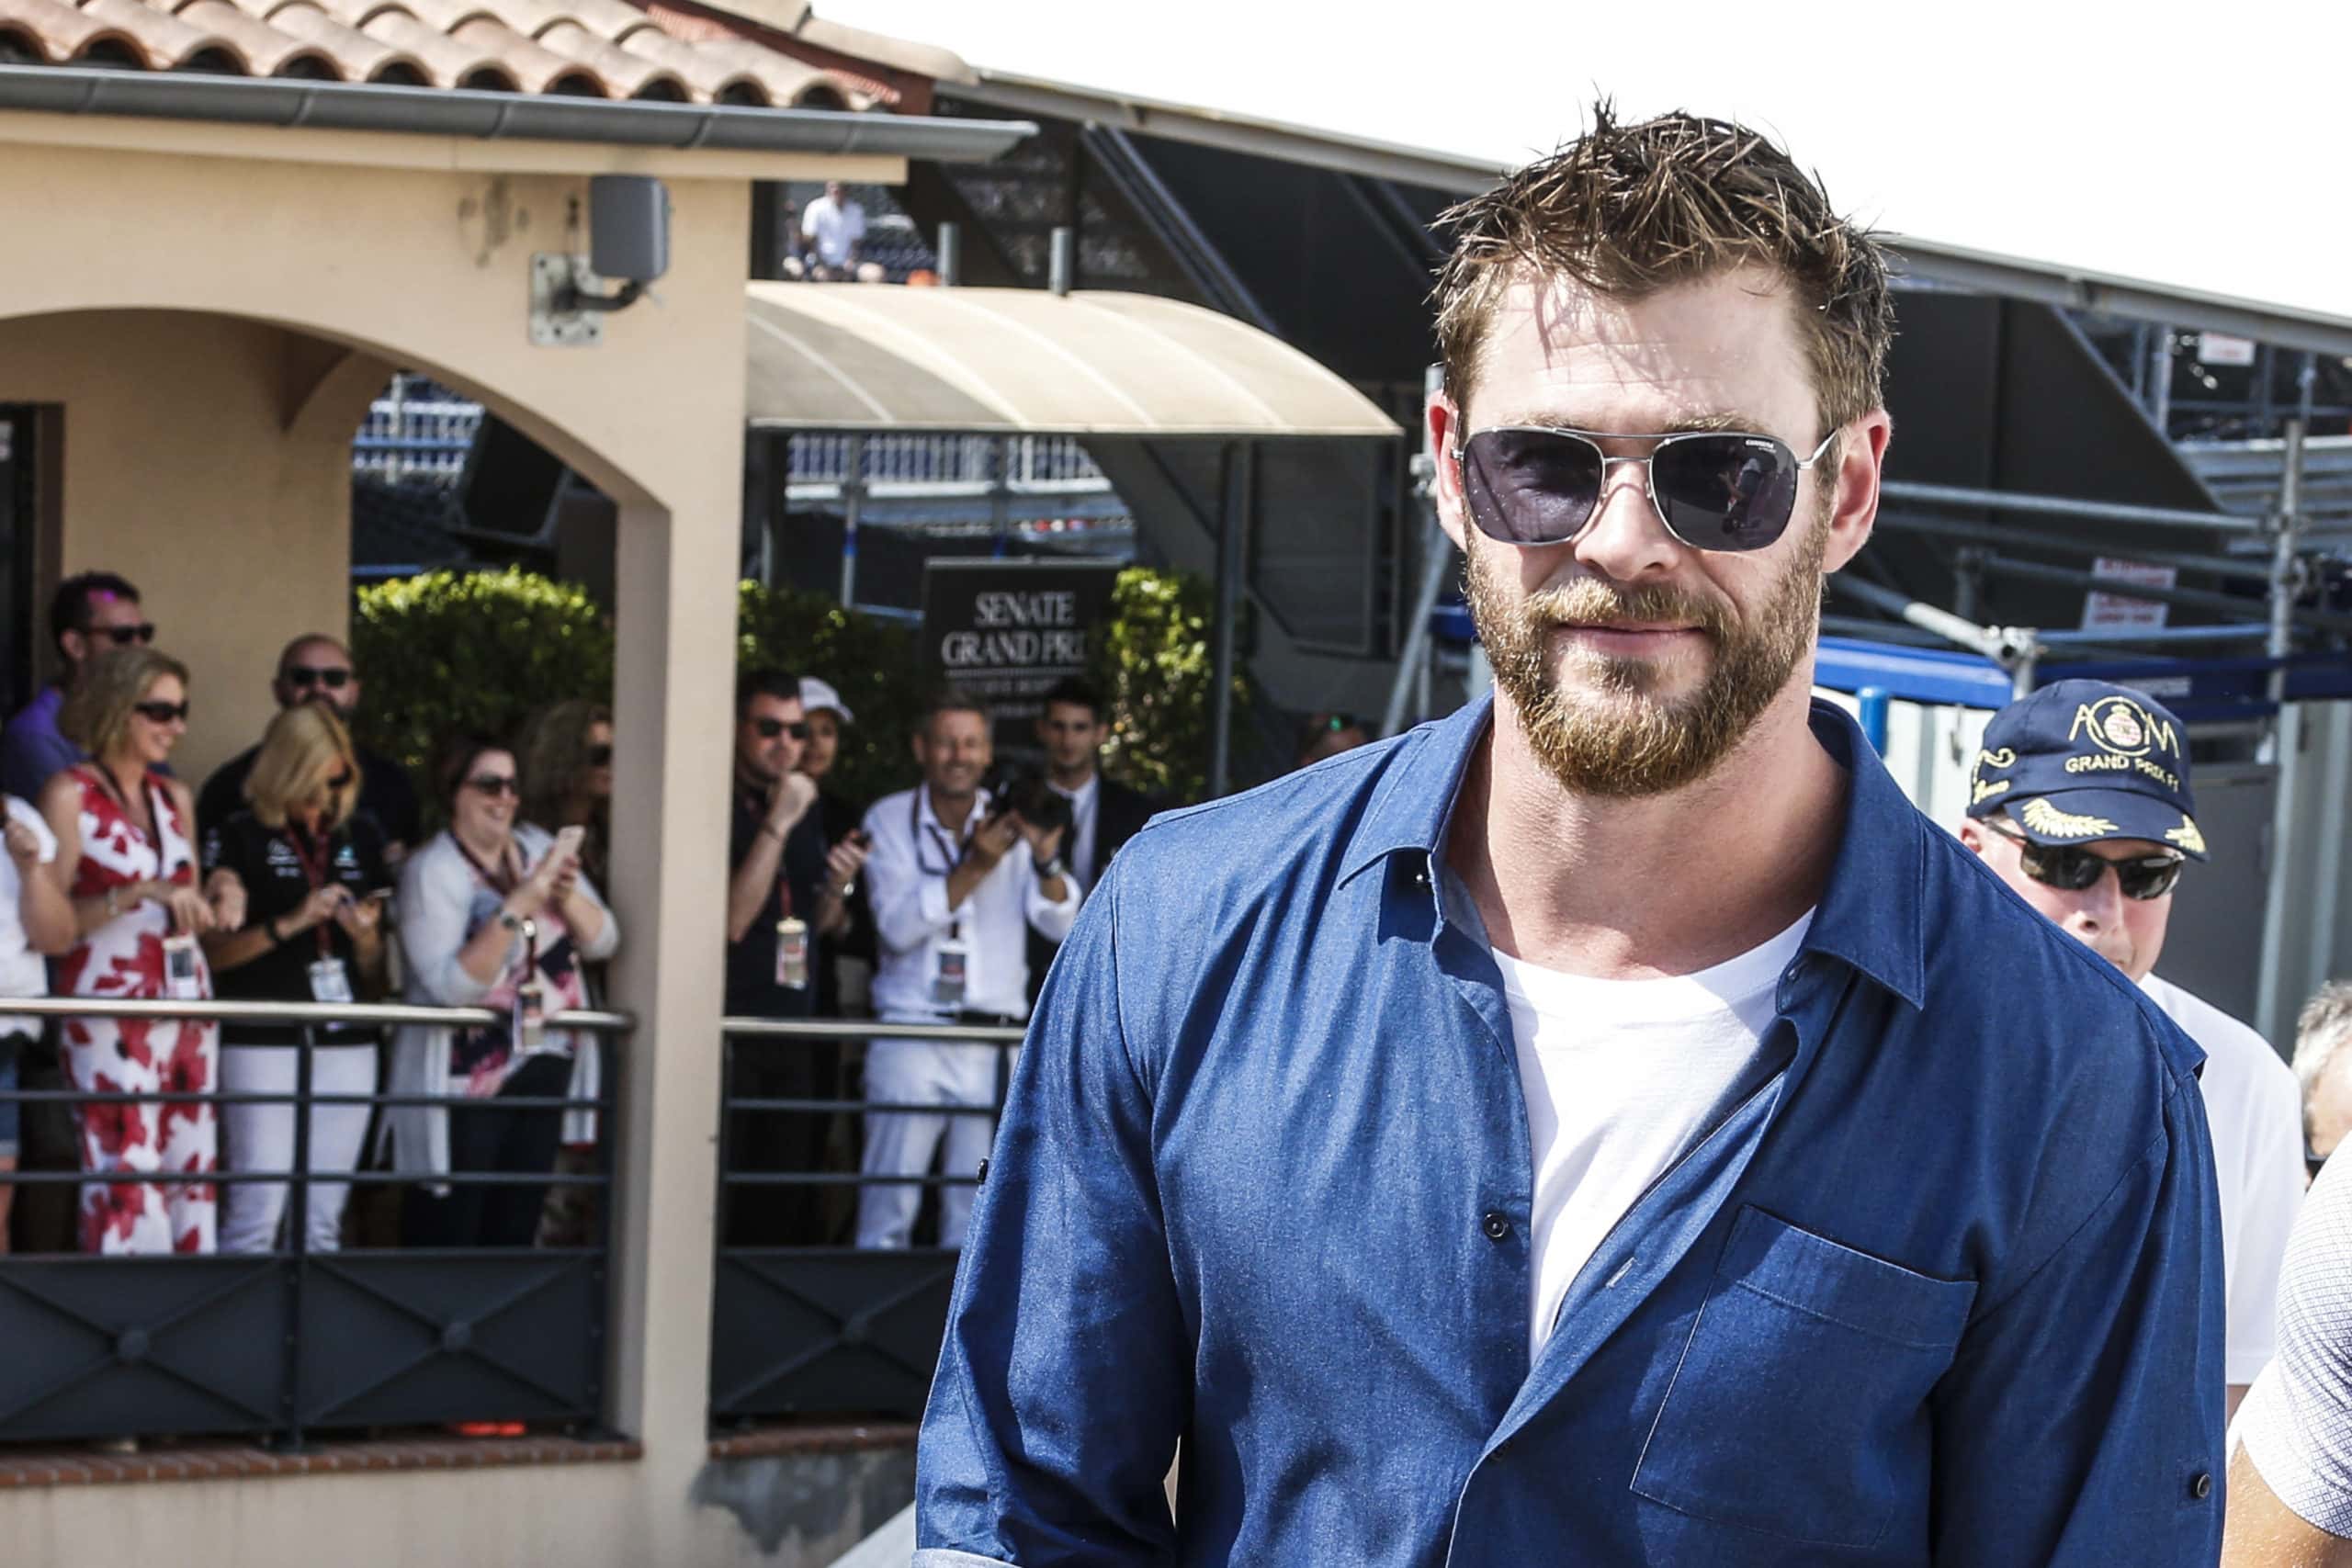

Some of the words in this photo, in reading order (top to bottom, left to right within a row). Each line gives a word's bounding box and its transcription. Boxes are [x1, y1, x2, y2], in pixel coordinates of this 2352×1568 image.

[975, 592, 1074, 626] SENATE
[941, 629, 1040, 666] GRAND
[1041, 630, 1085, 663] PRI
[2064, 754, 2130, 773] GRAND
